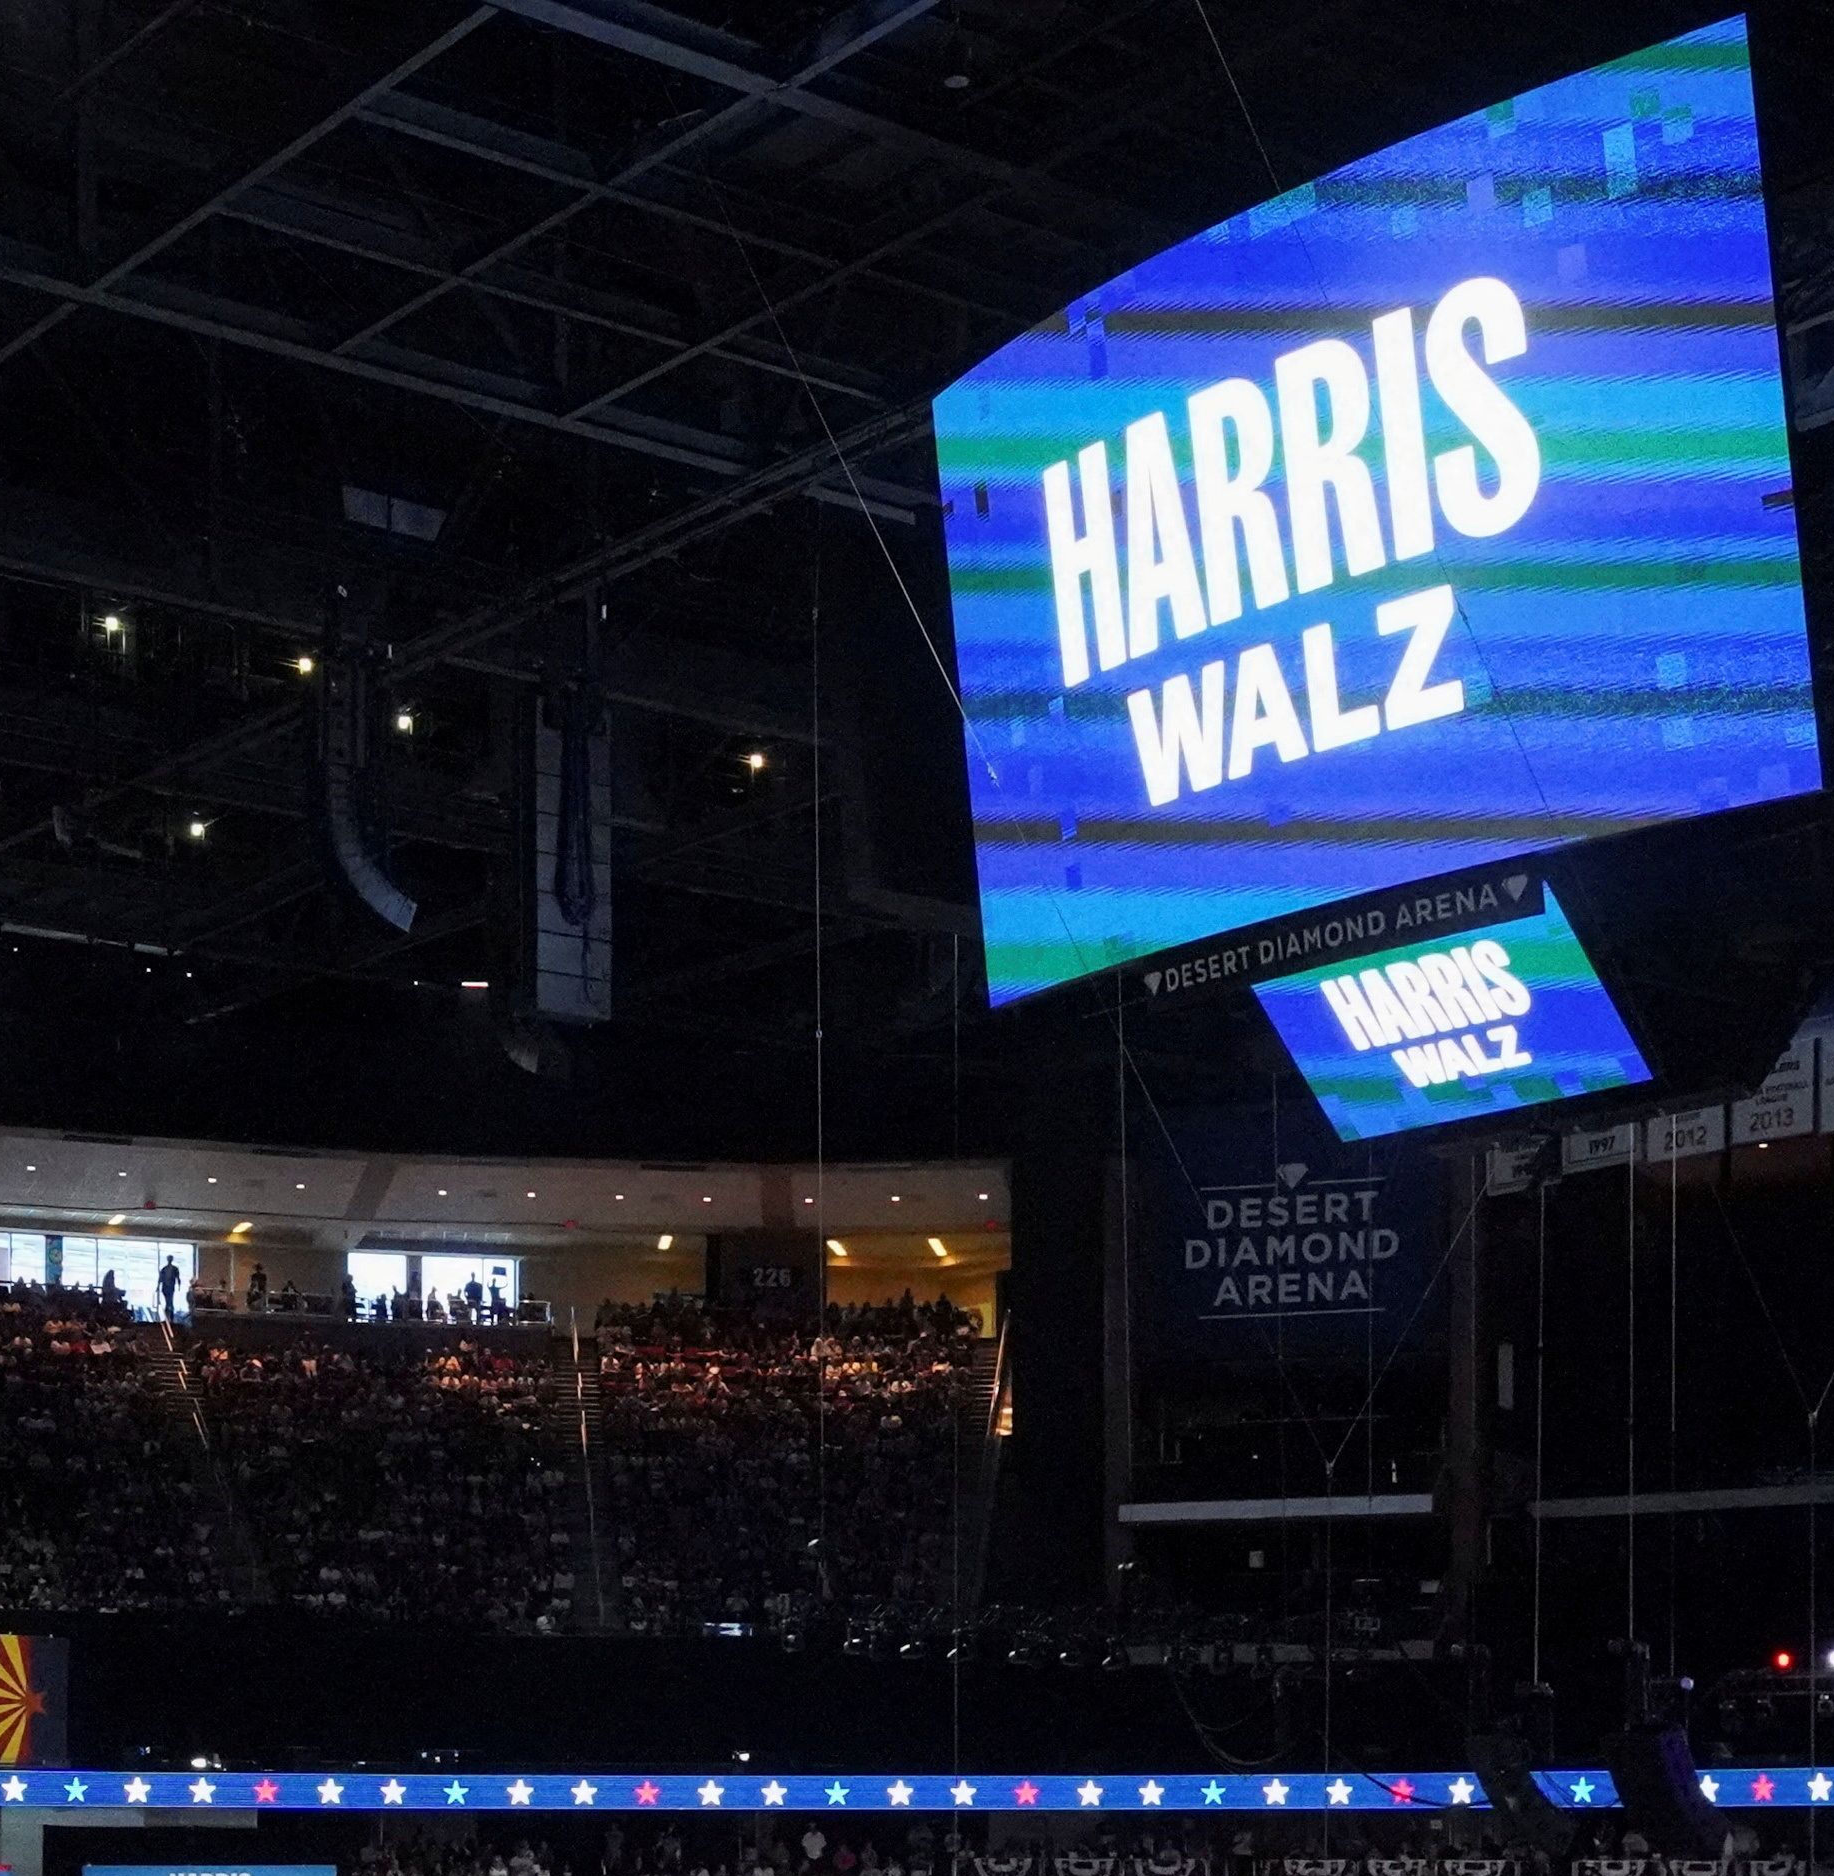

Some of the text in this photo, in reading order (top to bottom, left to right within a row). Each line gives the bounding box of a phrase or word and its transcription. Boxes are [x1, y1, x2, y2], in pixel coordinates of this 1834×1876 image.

[1042, 277, 1542, 687] HARRIS
[1126, 585, 1468, 806] WALZ
[1166, 882, 1498, 993] DESERT DIAMOND ARENA
[1320, 940, 1531, 1051] HARRIS
[1392, 1025, 1532, 1088] WALZ
[1665, 1126, 1707, 1150] 2012
[1750, 1107, 1794, 1133] 2013
[1207, 1190, 1379, 1230] DESERT
[1185, 1228, 1399, 1269] DIAMOND
[1213, 1270, 1369, 1306] ARENA
